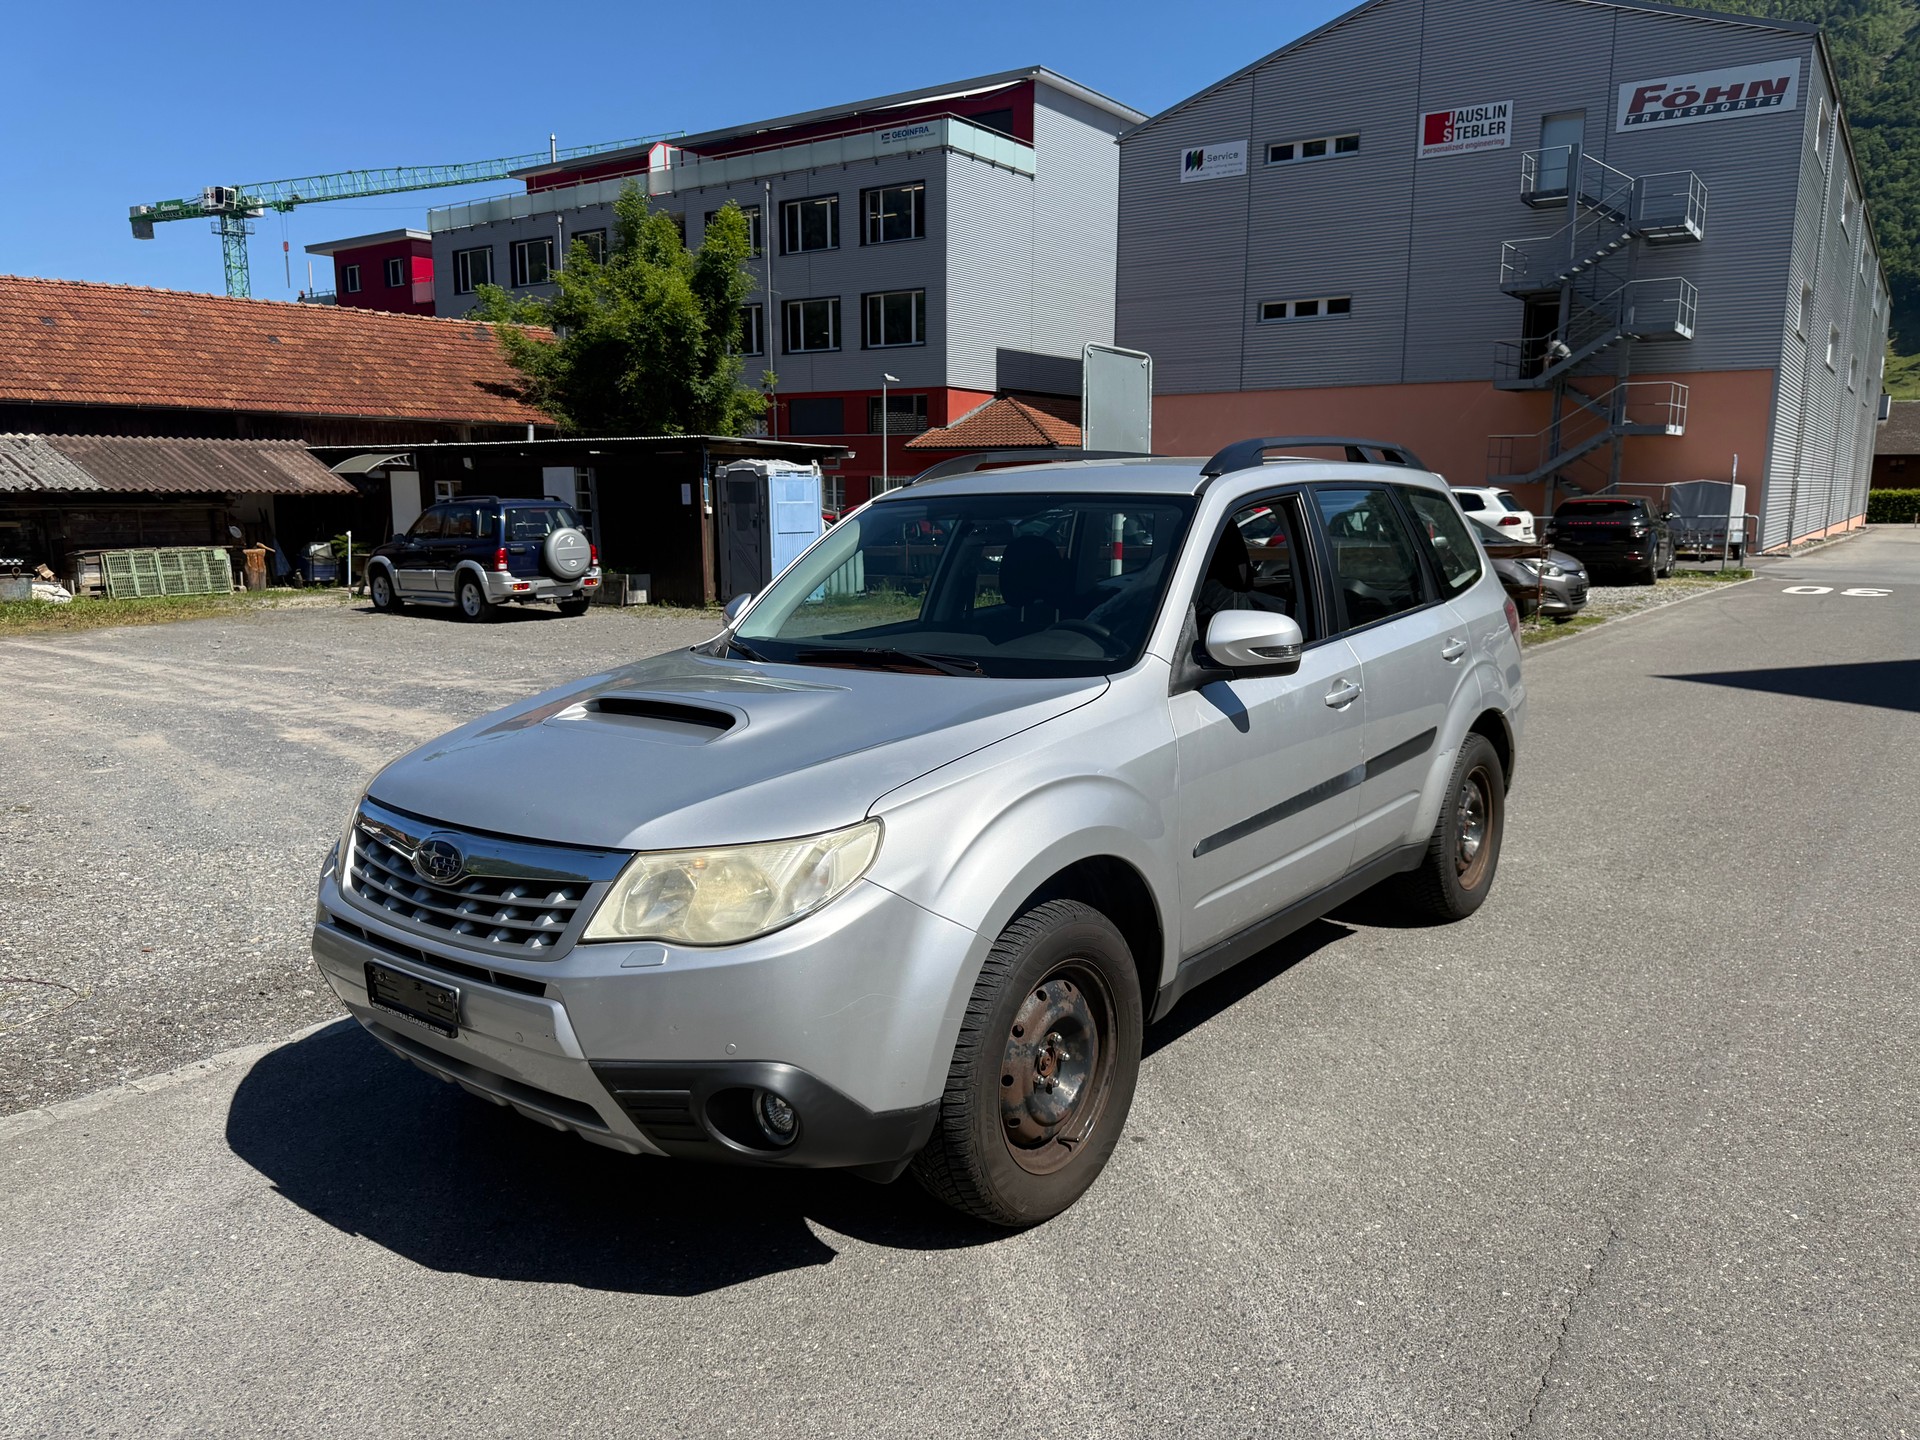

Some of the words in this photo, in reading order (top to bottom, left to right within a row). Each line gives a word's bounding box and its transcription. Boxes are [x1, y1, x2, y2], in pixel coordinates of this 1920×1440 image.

[1445, 104, 1507, 126] JAUSLIN
[1626, 95, 1780, 124] TRANSPORTE
[891, 125, 930, 139] GEOINFRA
[1443, 120, 1506, 142] STEBLER
[1422, 142, 1464, 156] personalized
[1465, 138, 1505, 152] engineering
